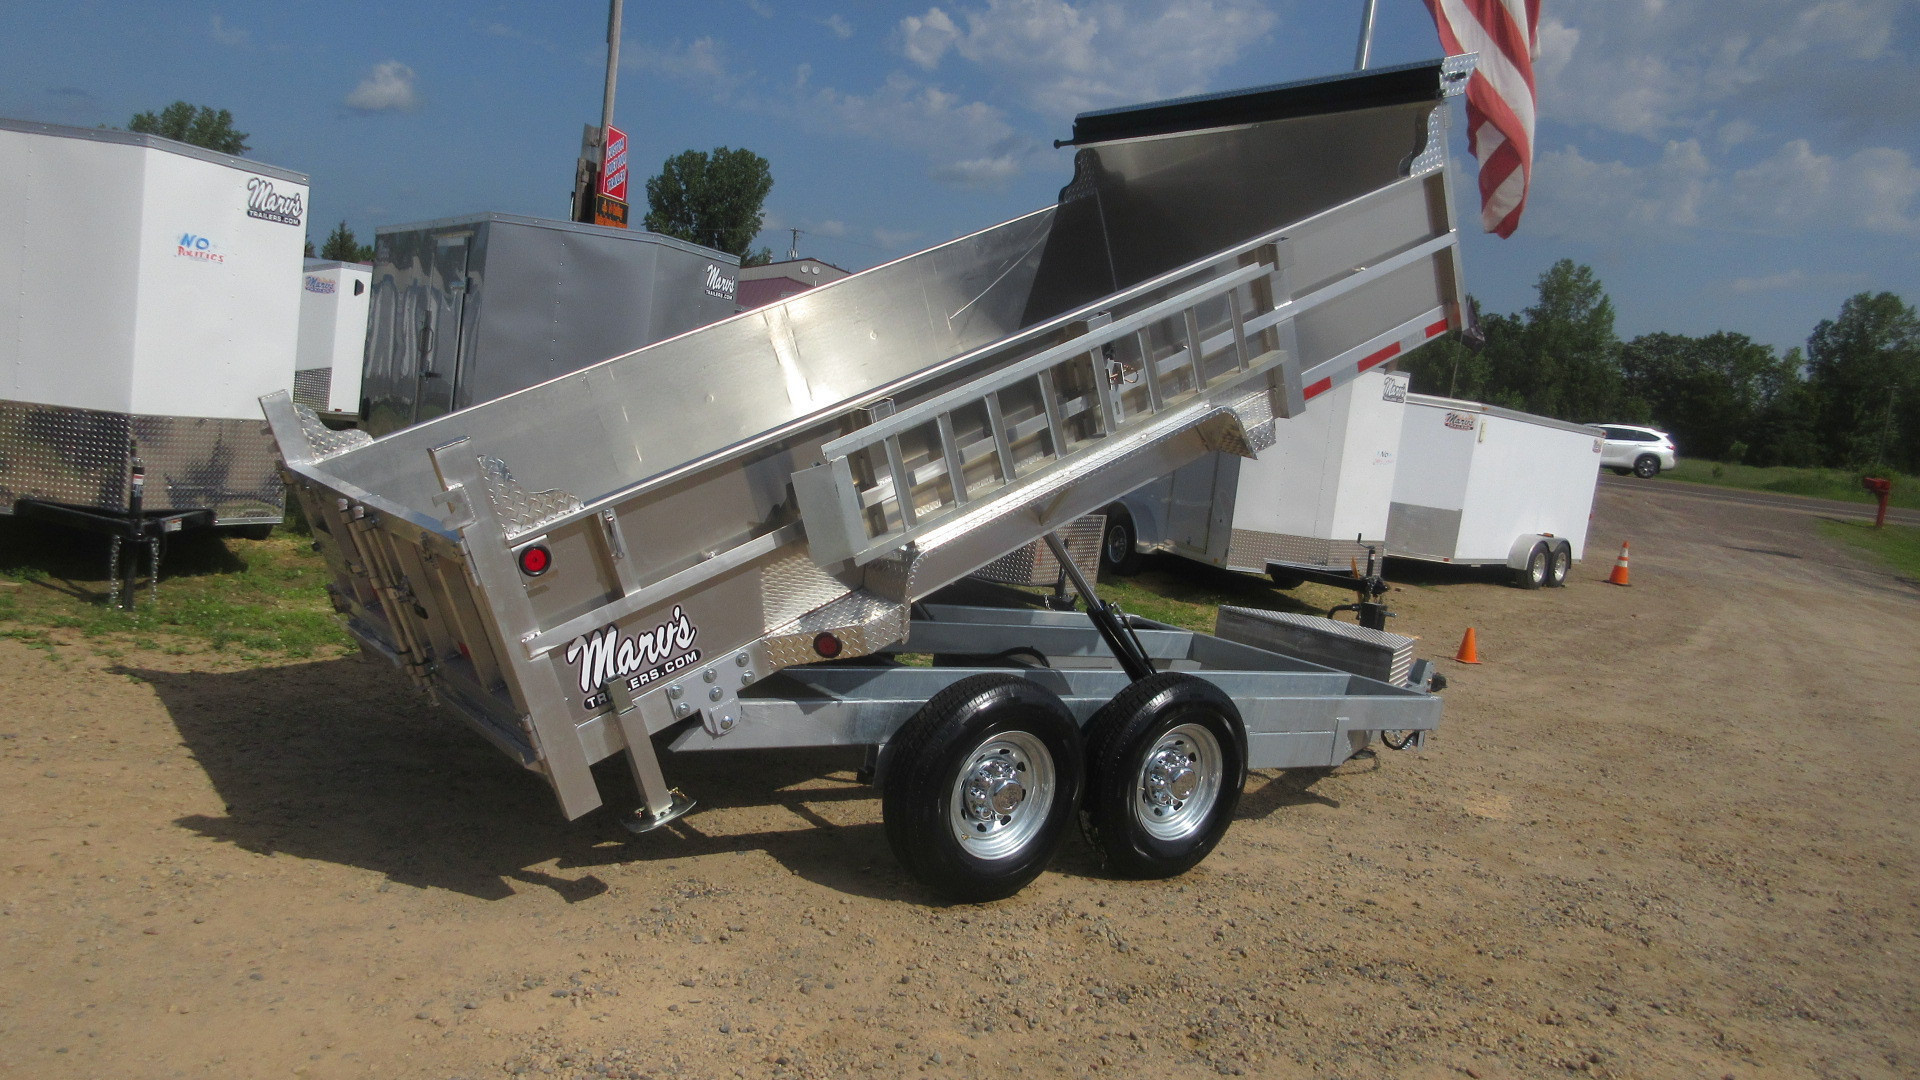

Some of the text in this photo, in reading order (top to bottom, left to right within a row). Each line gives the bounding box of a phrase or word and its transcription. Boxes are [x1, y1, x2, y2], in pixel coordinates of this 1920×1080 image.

[247, 177, 302, 216] Marv's
[249, 209, 300, 226] TRAILERS.COM
[180, 232, 210, 250] NO
[706, 264, 734, 293] Marv's
[567, 605, 697, 693] Marv's
[586, 650, 699, 708] TRERS.COM
